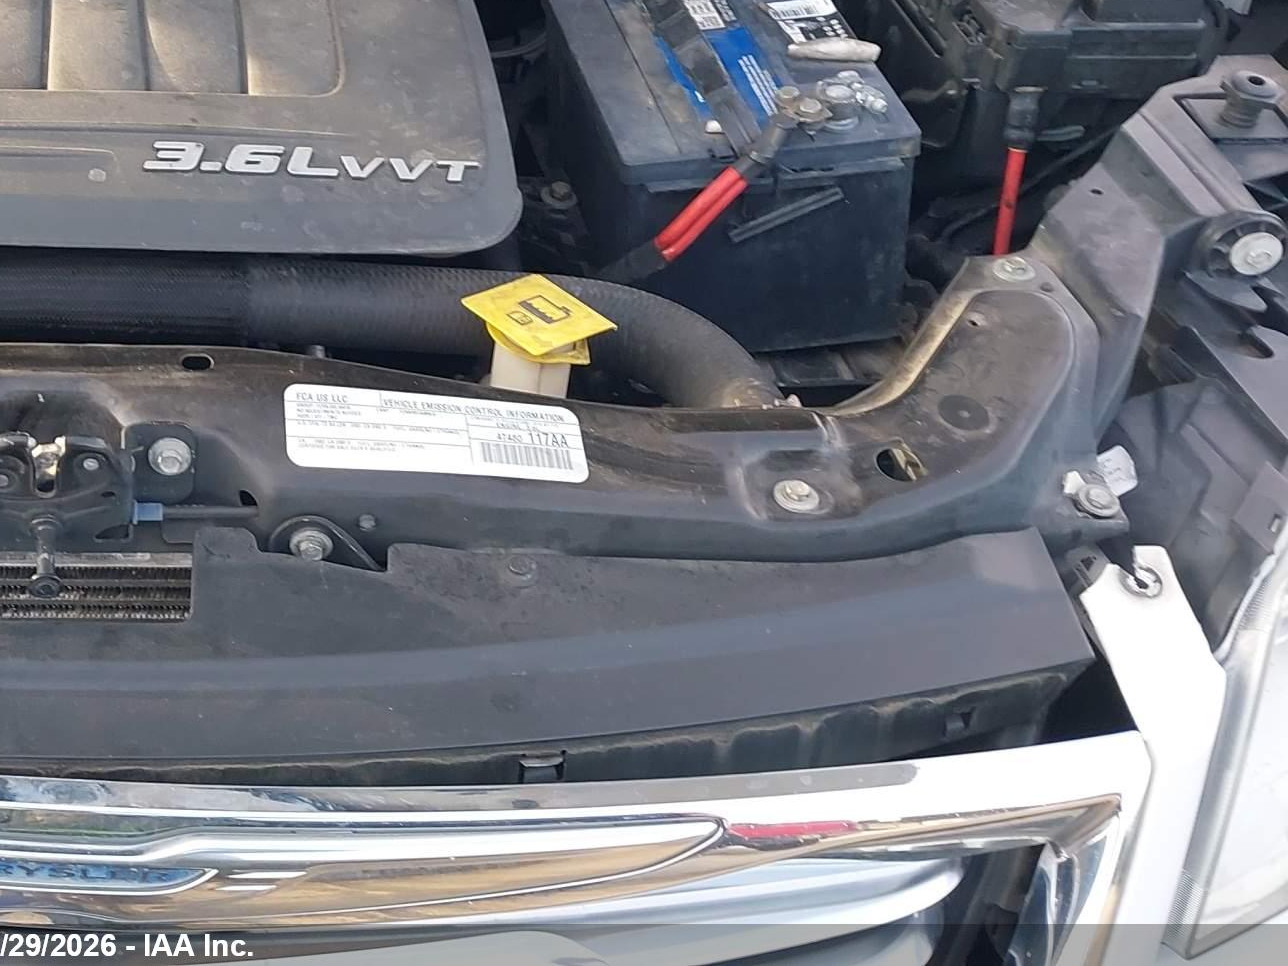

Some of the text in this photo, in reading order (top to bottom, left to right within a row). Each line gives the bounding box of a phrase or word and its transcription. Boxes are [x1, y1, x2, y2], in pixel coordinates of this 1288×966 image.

[295, 392, 350, 404] FCA US LLC
[383, 398, 420, 410] VEHICLE
[421, 401, 462, 413] EMISSION
[464, 405, 503, 417] CONTROL
[505, 409, 566, 422] INFORMATION
